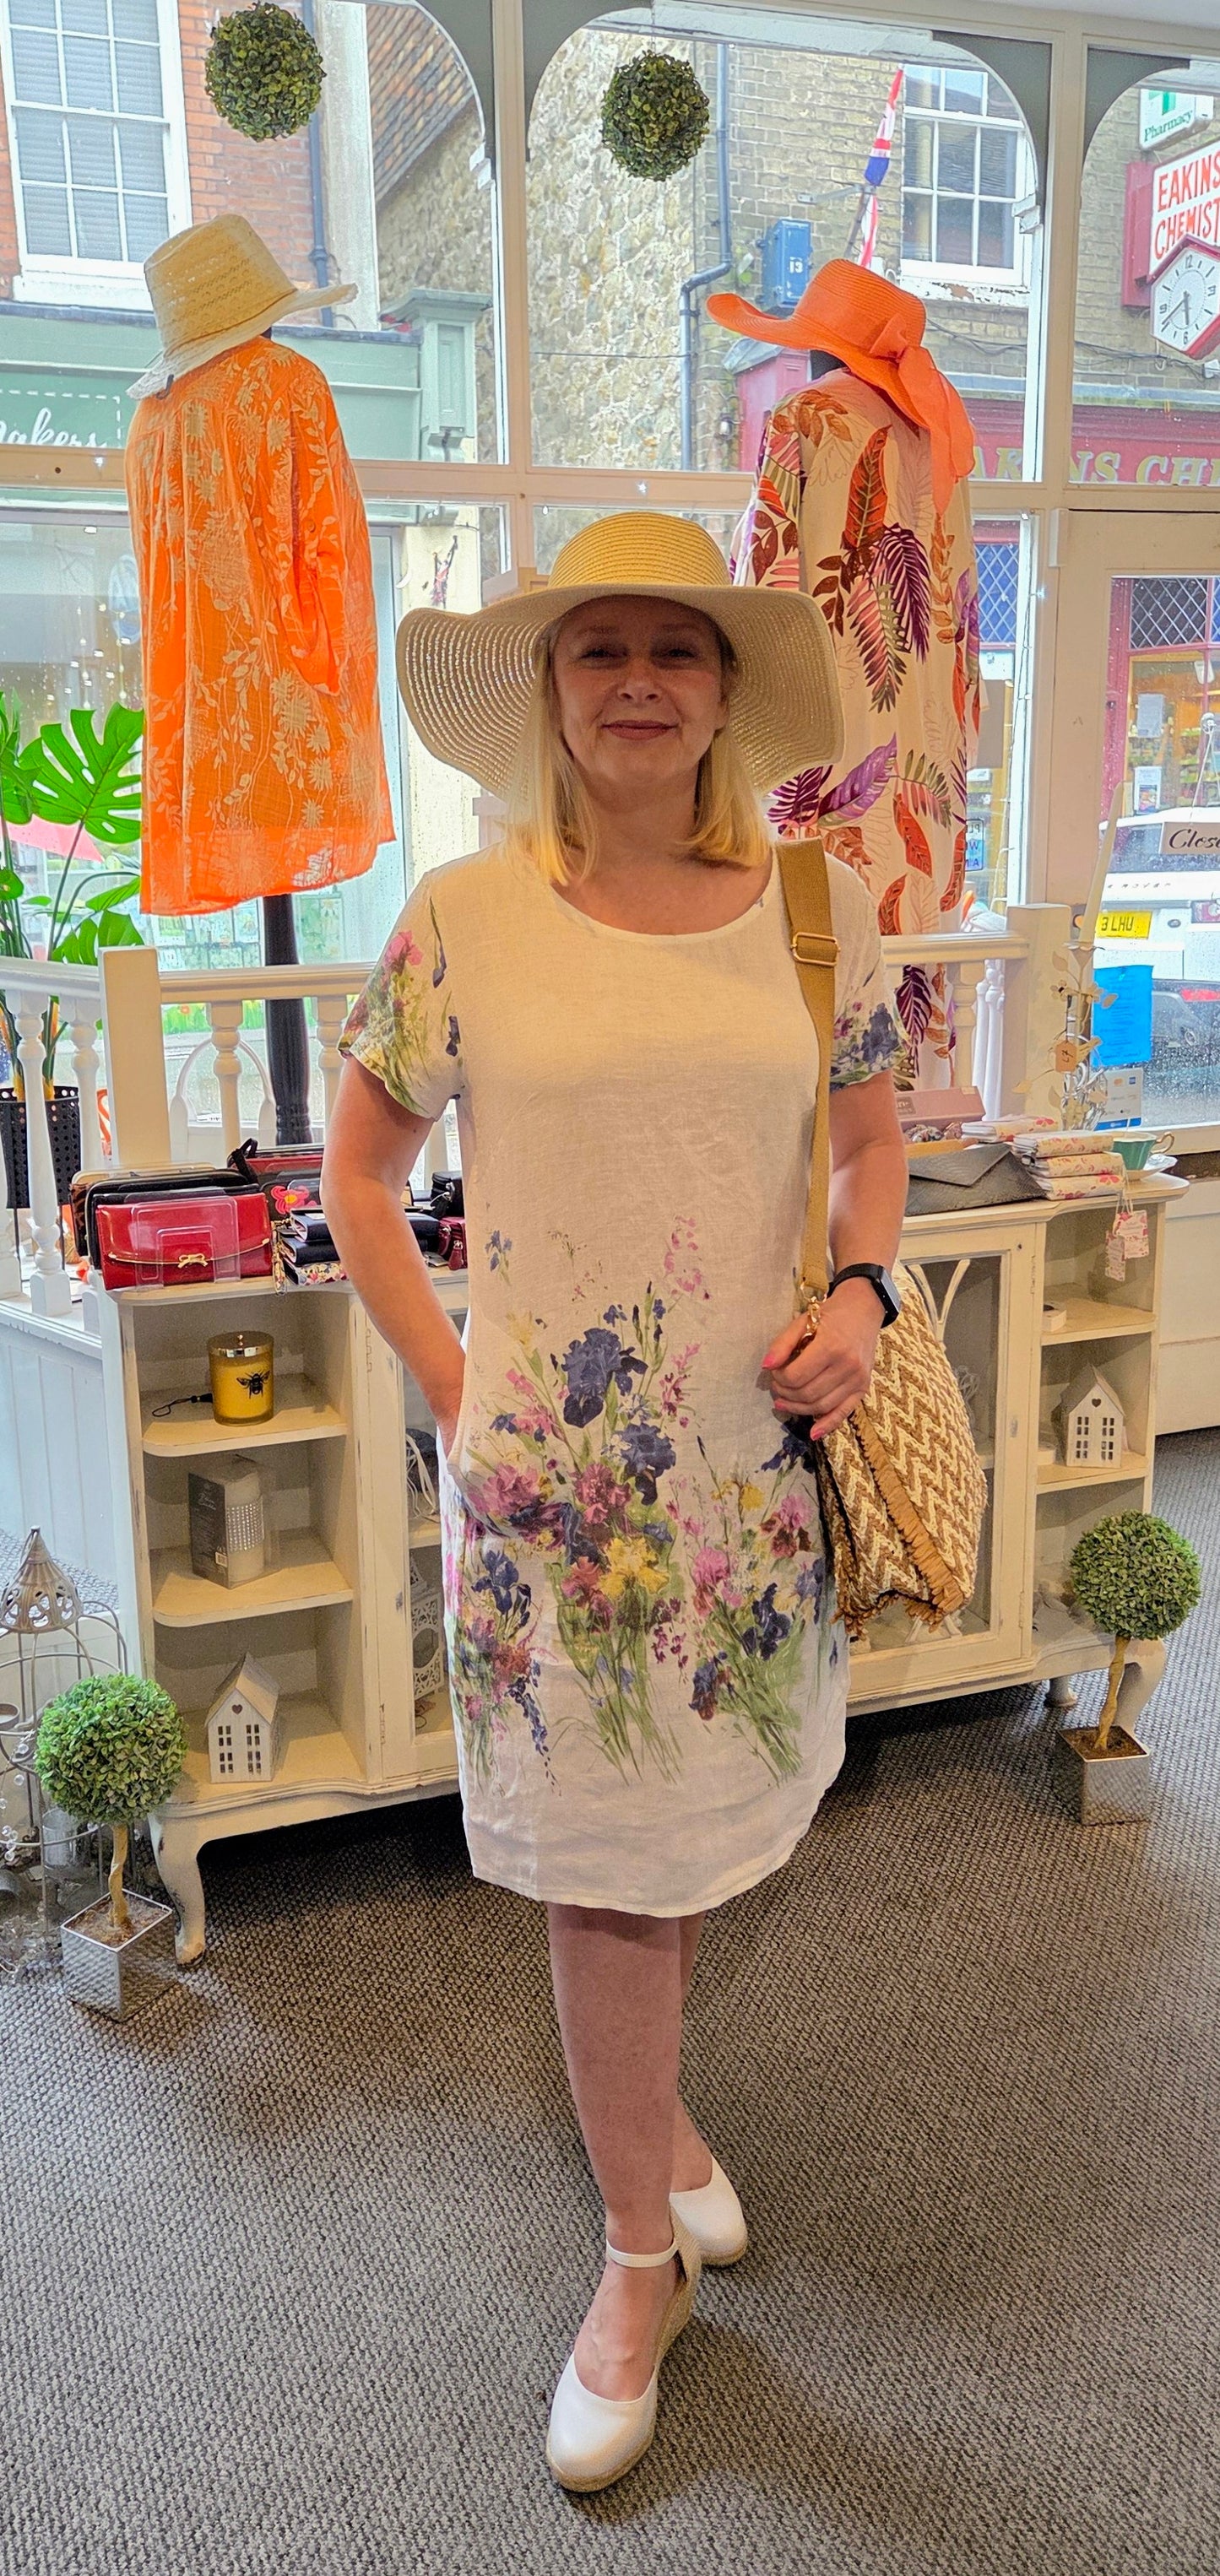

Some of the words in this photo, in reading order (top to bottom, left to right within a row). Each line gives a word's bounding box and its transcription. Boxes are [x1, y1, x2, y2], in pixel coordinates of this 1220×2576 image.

[1144, 110, 1193, 143] Pharmacy
[1158, 149, 1220, 213] EAKINS
[1155, 197, 1220, 260] CHEMIST
[0, 407, 107, 447] akers
[1110, 916, 1134, 931] LHU
